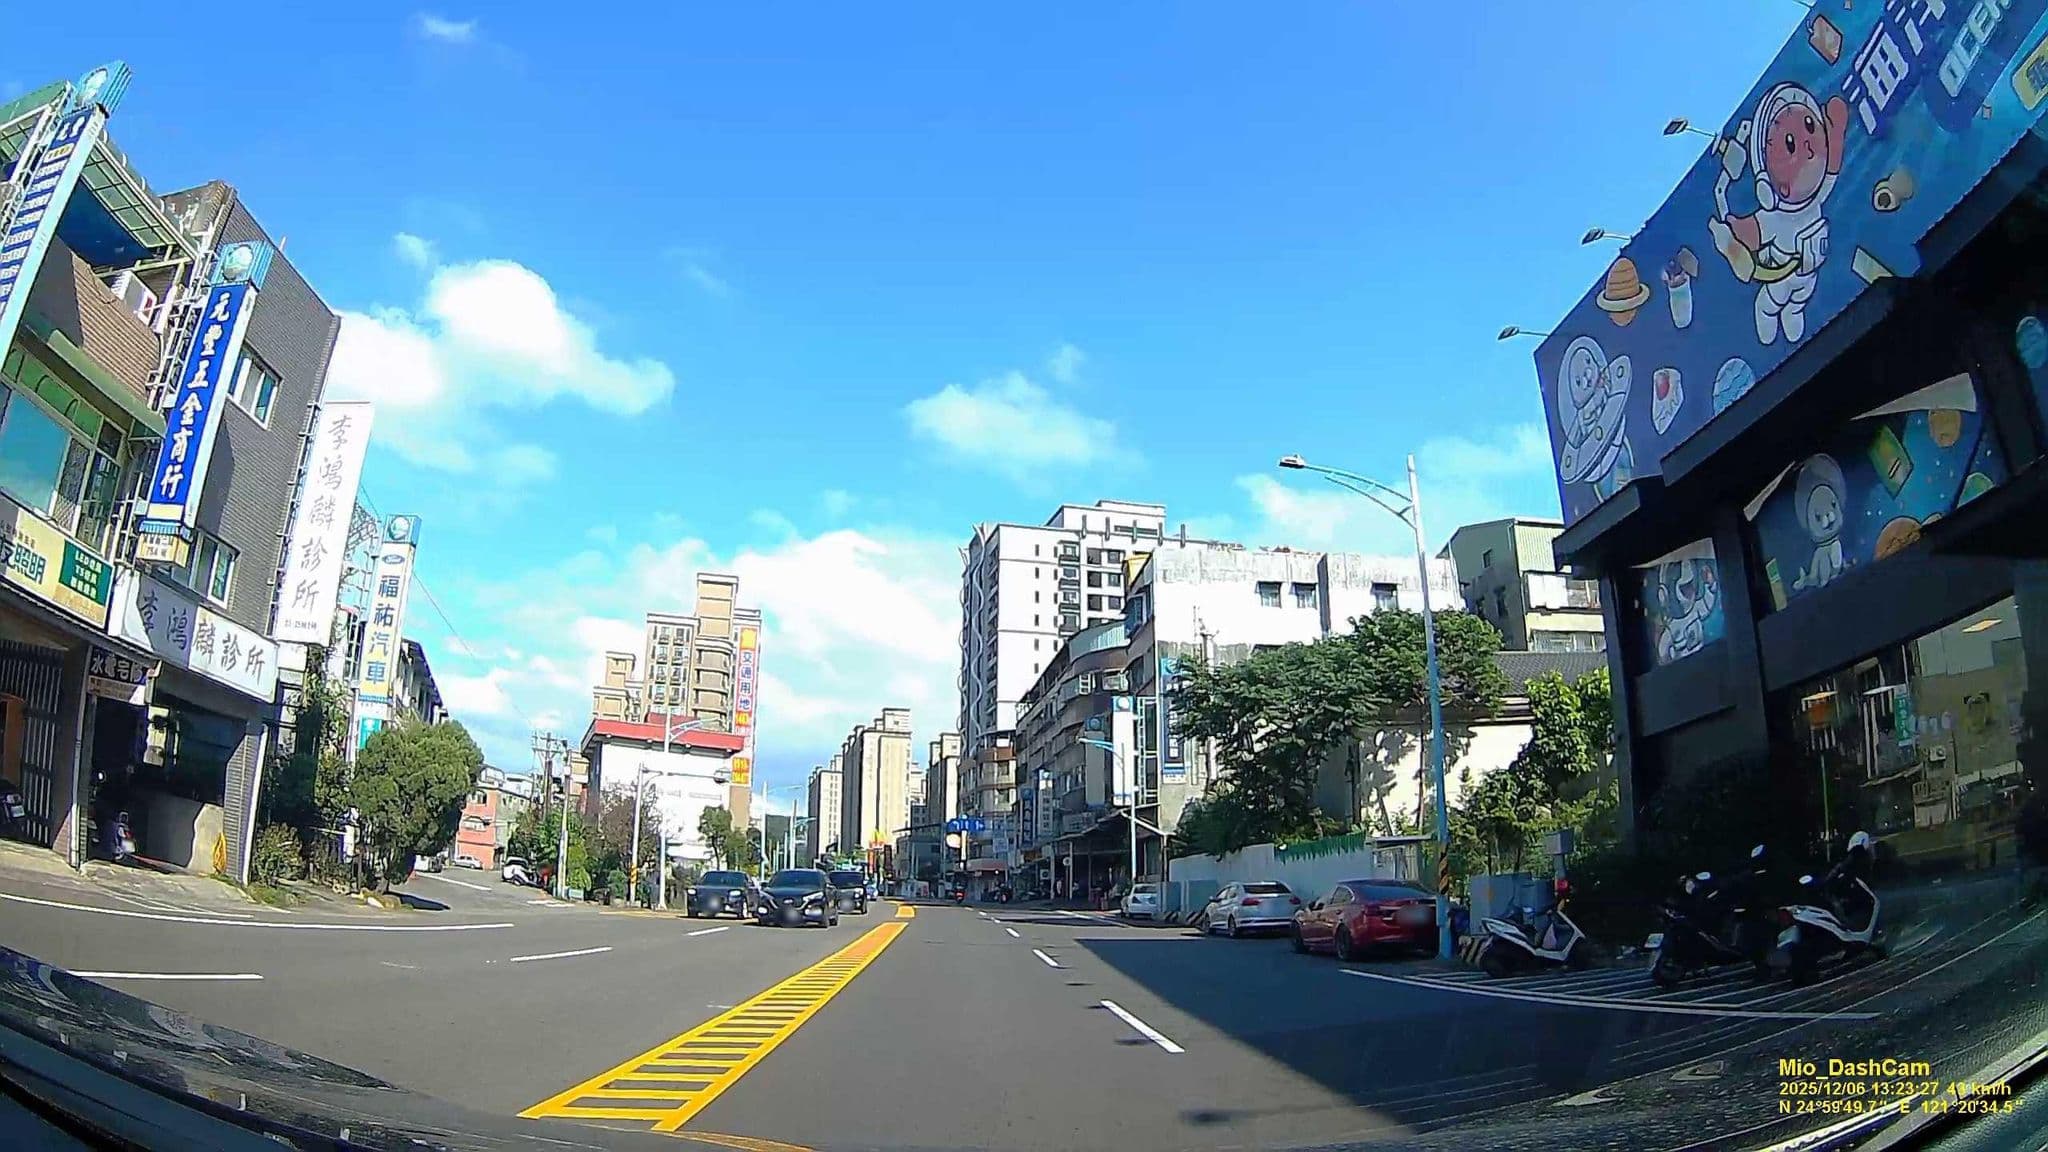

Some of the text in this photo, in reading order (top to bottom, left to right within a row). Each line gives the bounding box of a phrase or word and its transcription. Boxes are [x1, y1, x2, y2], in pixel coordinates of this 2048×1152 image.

[292, 414, 352, 613] 李鴻麟診所
[140, 590, 266, 685] 李鴻麟診所
[364, 574, 401, 685] 福祐汽車
